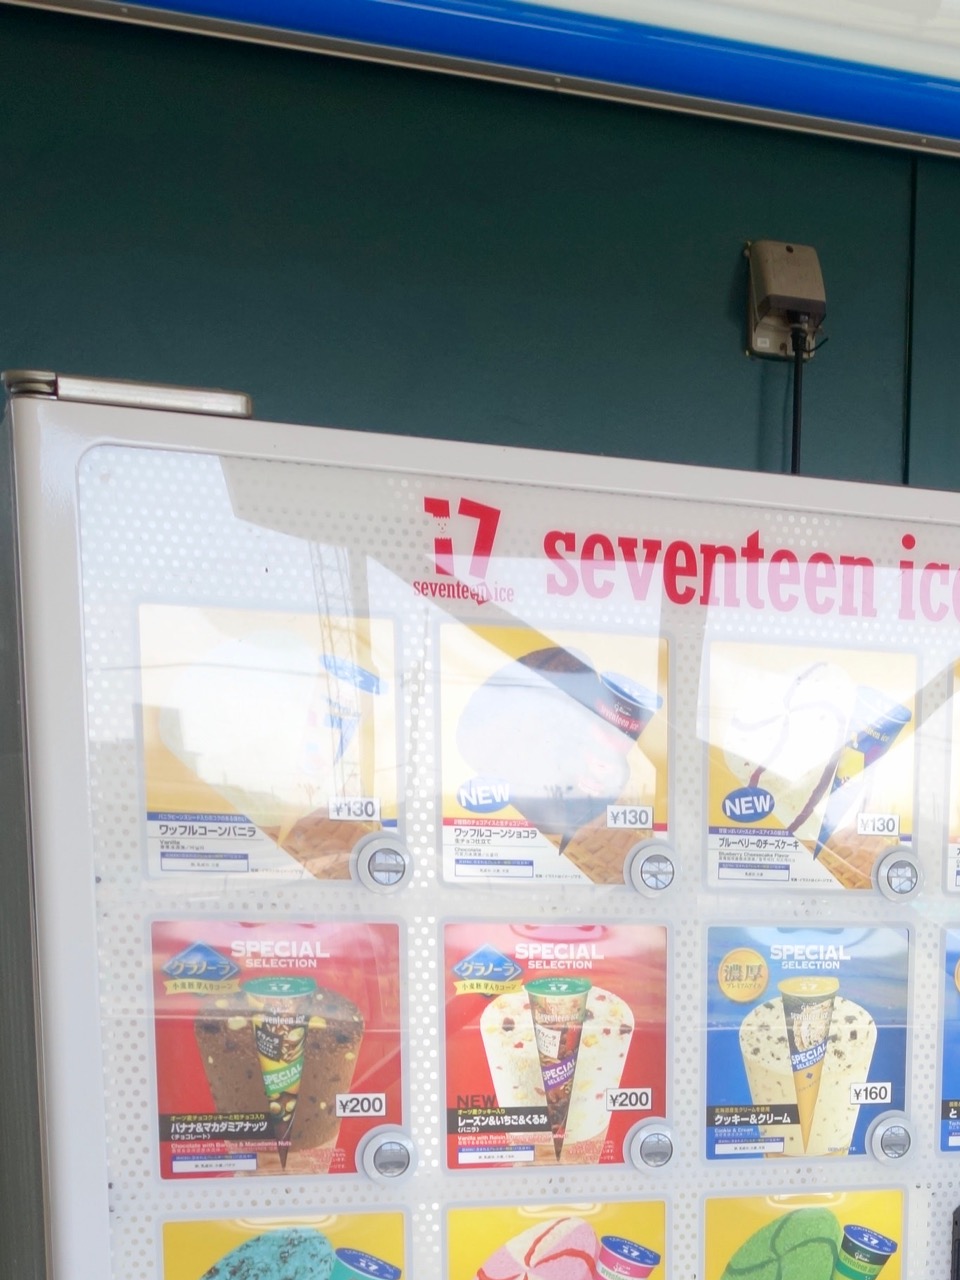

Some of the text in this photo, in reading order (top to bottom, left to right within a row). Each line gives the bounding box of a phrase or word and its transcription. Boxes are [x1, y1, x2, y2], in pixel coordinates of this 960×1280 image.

[543, 529, 877, 618] seventeen
[413, 579, 515, 602] seventeen ice
[457, 782, 510, 808] NEW
[333, 800, 377, 818] ¥130
[724, 795, 771, 817] NEW
[610, 809, 649, 826] ¥130
[860, 816, 896, 833] ¥130
[159, 824, 257, 838] ワッフルコーンバニラ
[454, 828, 537, 839] ワッフルコーンショコラ
[719, 838, 800, 850] ブルーベリーのチーズケーキ
[231, 940, 330, 958] SPECIAL
[515, 943, 604, 960] SPECIAL
[770, 944, 851, 961] SPECIAL
[170, 960, 232, 976] グラノーラ
[245, 958, 317, 968] SELECTION
[461, 960, 516, 976] グラノーラ
[528, 960, 593, 969] SELECTION
[782, 961, 840, 970] SELECTION
[724, 964, 763, 983] 濃厚
[791, 1043, 826, 1065] SPECIAL
[264, 1064, 302, 1085] SPECIAL
[543, 1059, 575, 1081] SPECIAL
[456, 1094, 496, 1108] NEW
[609, 1092, 649, 1106] ¥200
[854, 1086, 888, 1100] ¥160
[339, 1097, 383, 1113] ¥200
[171, 1121, 268, 1133] バナナ&マカダミアナッツ
[458, 1115, 548, 1127] レーズン&いちご&くるみ
[714, 1113, 791, 1125] クッキー&クリーム
